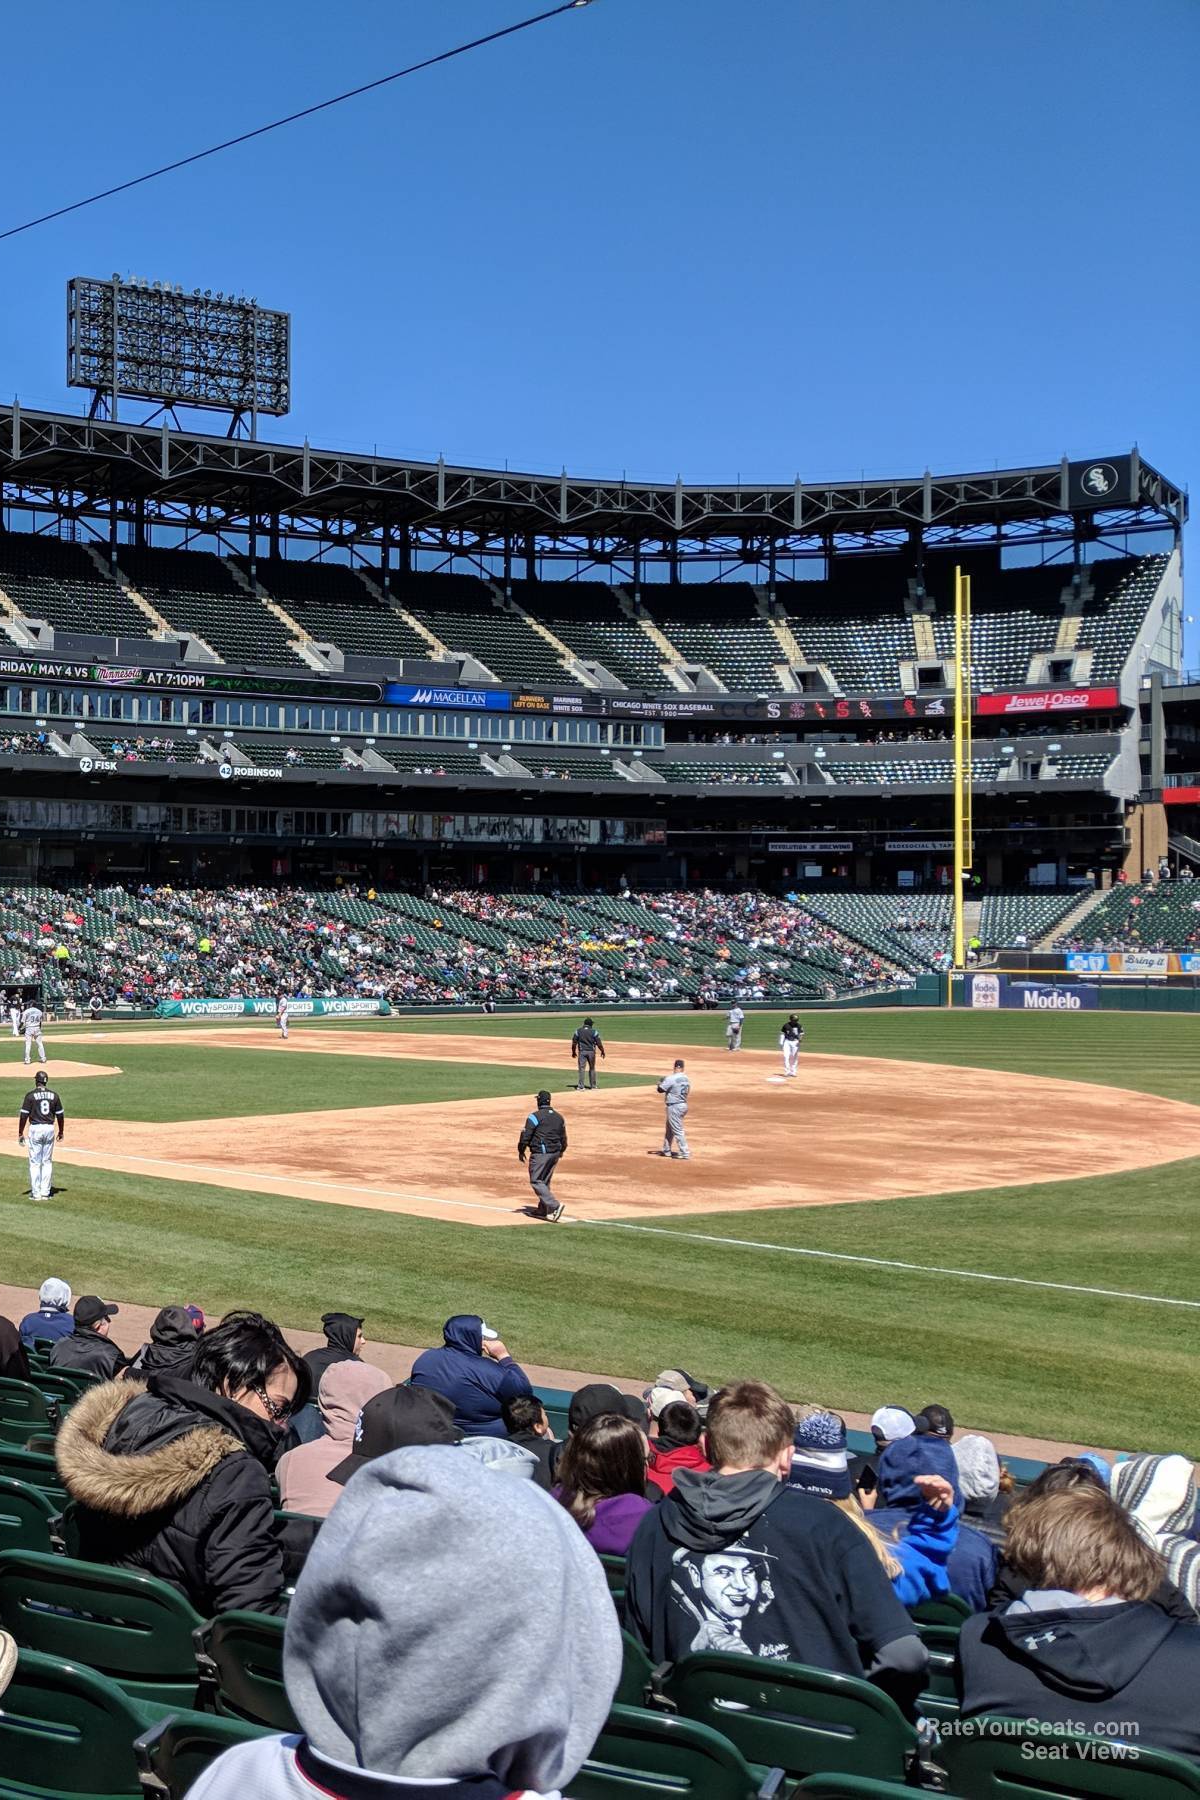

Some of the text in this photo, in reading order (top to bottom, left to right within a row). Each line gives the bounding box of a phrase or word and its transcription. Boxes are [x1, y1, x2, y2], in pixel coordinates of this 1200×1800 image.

[39, 665, 62, 677] MAY
[64, 669, 72, 678] 4
[74, 670, 88, 679] VS
[96, 668, 142, 680] Minnesota
[147, 673, 205, 687] AT 7:10PM
[432, 692, 486, 704] MAGELLAN
[1008, 693, 1089, 708] Jewel-Osco
[612, 701, 641, 709] CHICAGO
[81, 760, 117, 771] 72 FISK
[221, 766, 282, 778] 42 ROBINSON
[1125, 955, 1154, 966] Bring
[1024, 990, 1080, 1009] Modelo
[181, 1002, 210, 1013] WGN
[323, 1002, 380, 1012] WGN SPORTS
[40, 1100, 50, 1115] 8
